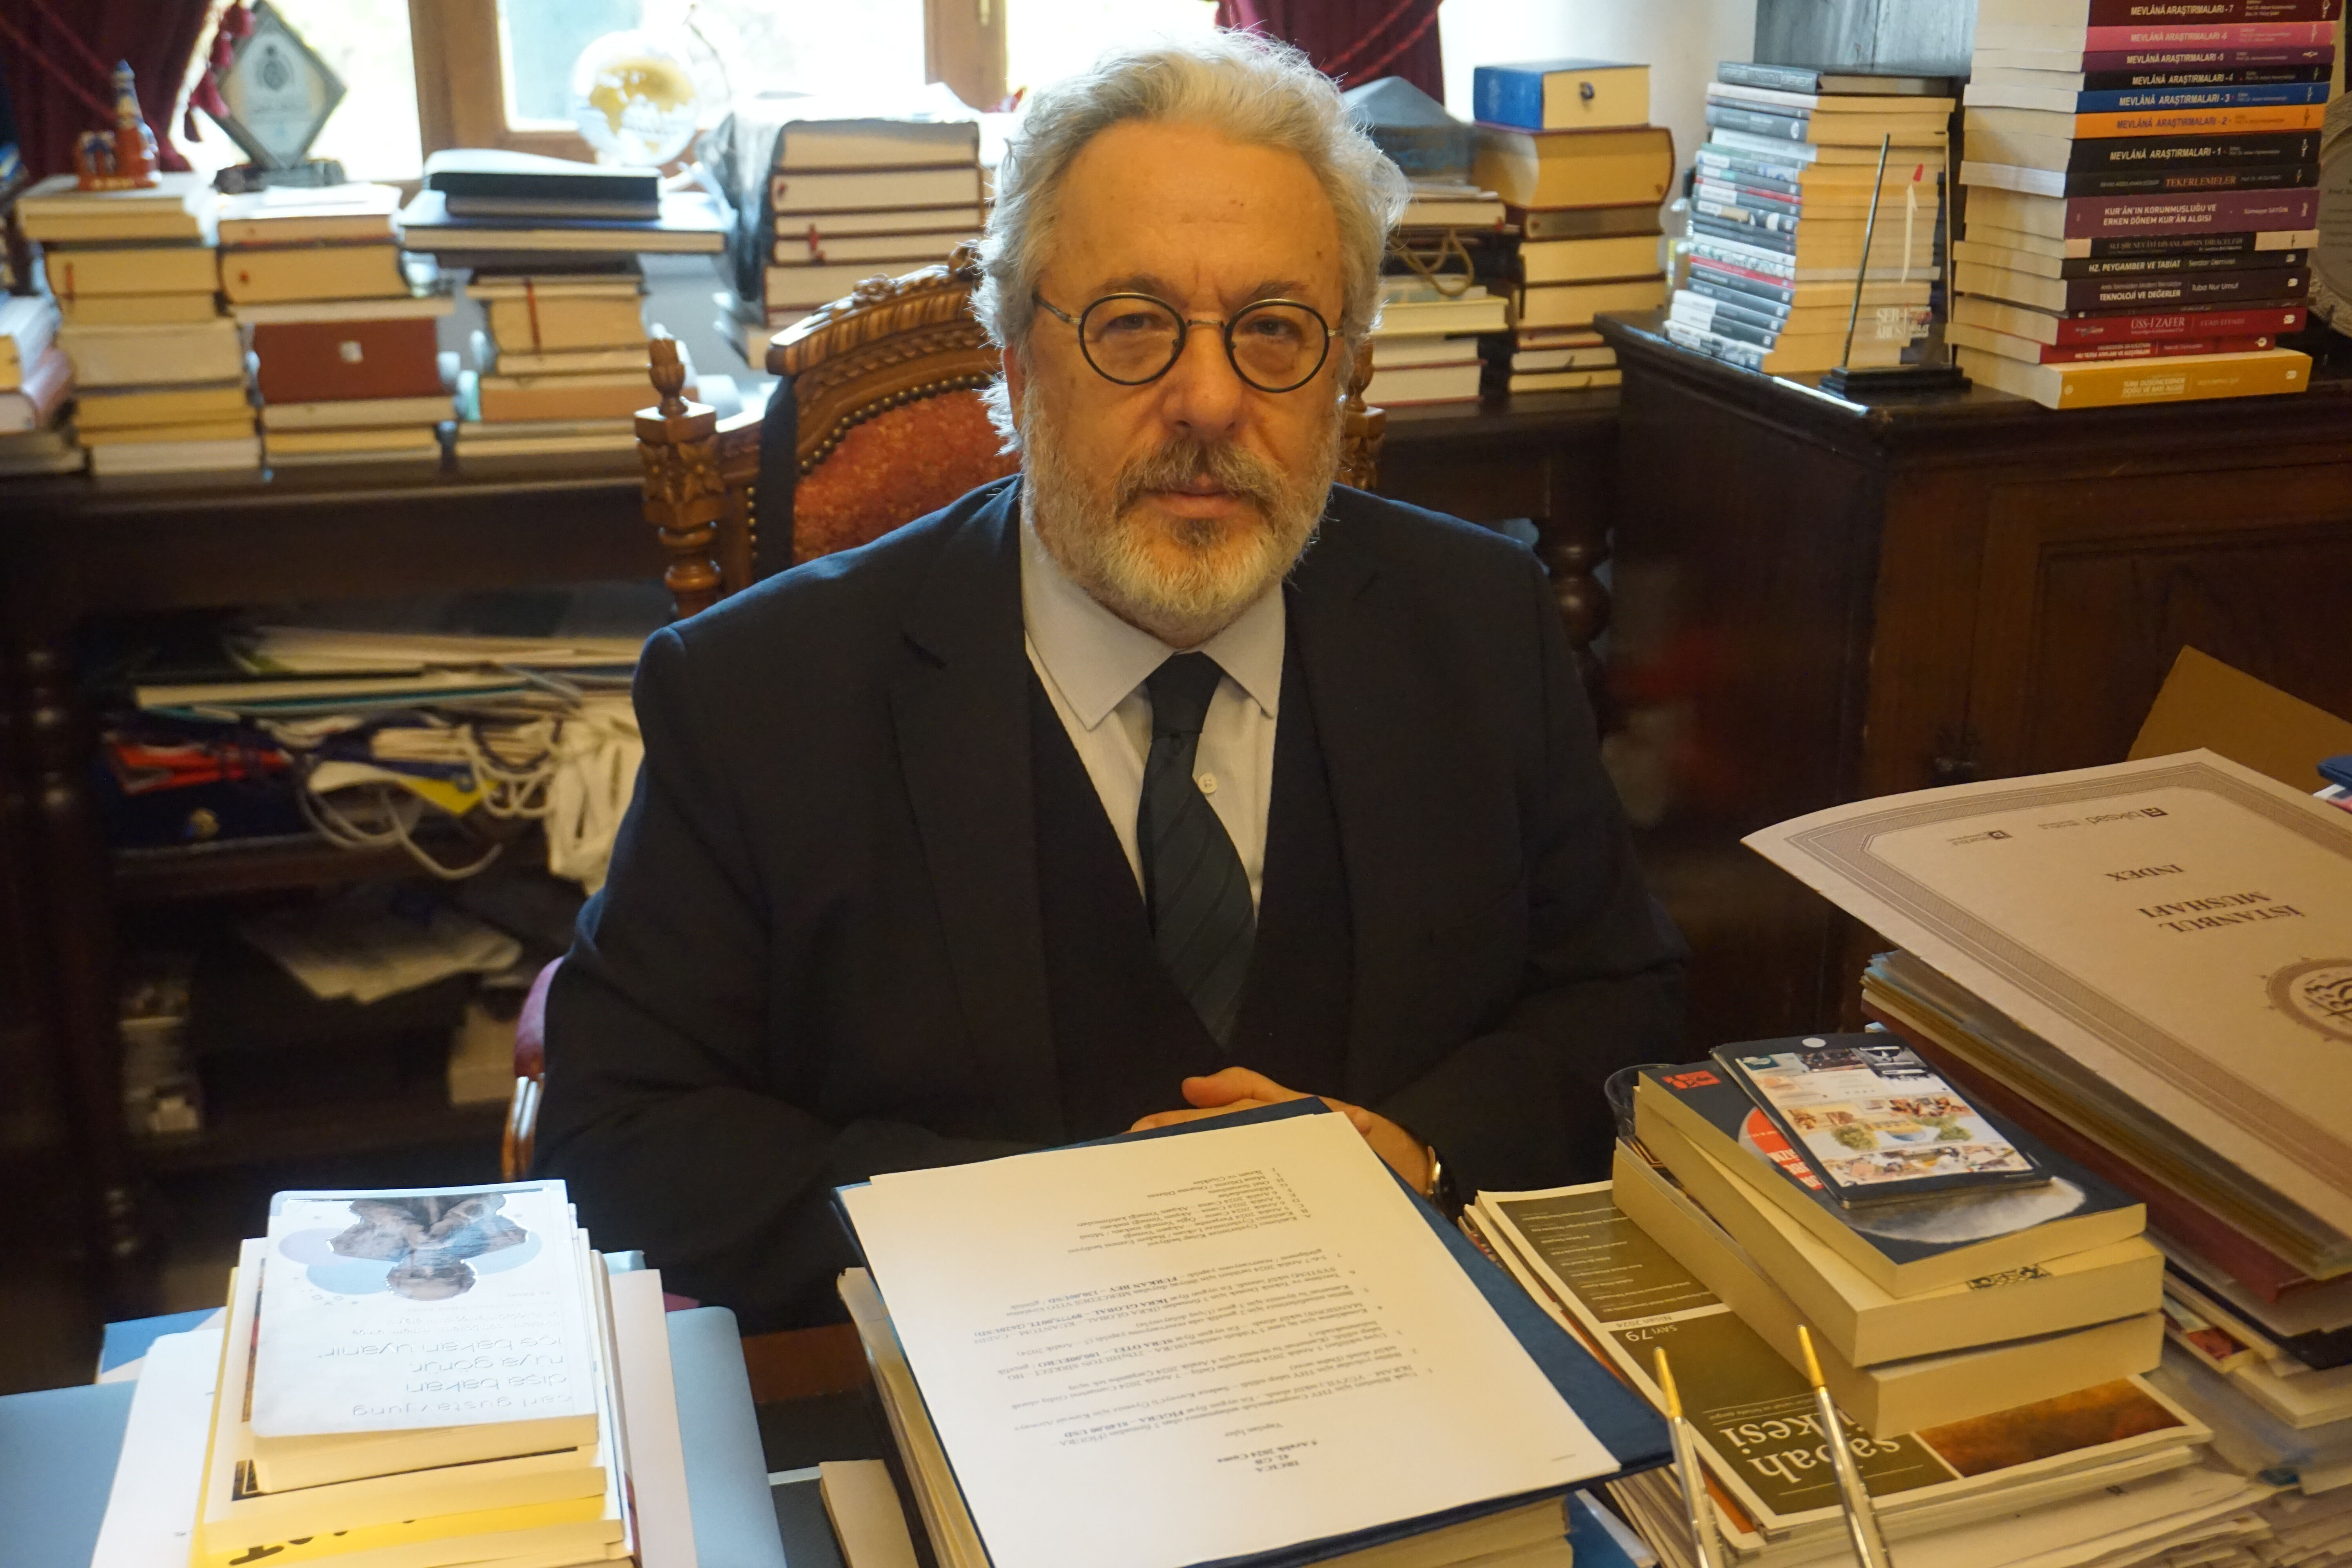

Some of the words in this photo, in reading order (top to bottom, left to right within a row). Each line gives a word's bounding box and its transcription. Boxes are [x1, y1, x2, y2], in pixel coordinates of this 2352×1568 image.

[2131, 7, 2165, 16] MEVLÂNÂ
[2166, 5, 2224, 16] ARAŞTIRMALARI
[2131, 32, 2163, 42] MEVLÂNÂ
[2165, 31, 2220, 42] ARAŞTIRMALARI
[2127, 55, 2160, 64] MEVLÂNÂ
[2161, 54, 2217, 64] ARAŞTIRMALARI
[2132, 74, 2166, 85] MEVLÂNÂ
[2168, 73, 2225, 85] ARAŞTIRMALARI
[2120, 96, 2155, 106] MEVLÂNÂ
[2158, 94, 2219, 105] ARAŞTIRMALARI
[2117, 119, 2152, 129] MEVLÂNÂ
[2156, 117, 2216, 128] ARAŞTIRMALARI
[2110, 150, 2146, 160] MEVLÂNÂ
[2149, 148, 2211, 160] ARAŞTIRMALARI
[2166, 176, 2236, 187] TEKERLEMELER
[2103, 216, 2129, 225] ERKEN
[2130, 215, 2157, 225] DÖNEM
[2102, 261, 2145, 271] PEYGAMBER
[2157, 259, 2181, 269] TABİAT
[2100, 291, 2136, 301] TEKNOLOJİ
[2148, 289, 2181, 299] DEĞERLER
[2156, 317, 2185, 327] ZAFER
[2103, 864, 2185, 882] INDEX
[2136, 891, 2270, 918] MUSHAFI
[2159, 904, 2305, 933] İSTANBUL
[1133, 1276, 1177, 1287] FURKAN
[1095, 1304, 1138, 1314] GLOBAL
[1089, 1312, 1129, 1322] GLOBAL
[1643, 1315, 1672, 1325] Nisan
[1616, 1319, 1641, 1329] 2024
[1651, 1324, 1678, 1334] SAYI
[1625, 1328, 1653, 1341] 79
[423, 1339, 512, 1354] bakan
[520, 1335, 562, 1347] içe
[502, 1354, 563, 1367] rüya
[406, 1378, 499, 1393] bakan
[507, 1373, 566, 1387] dışa
[421, 1396, 512, 1412] gustav
[523, 1394, 572, 1406] carl
[352, 1403, 411, 1416] jung
